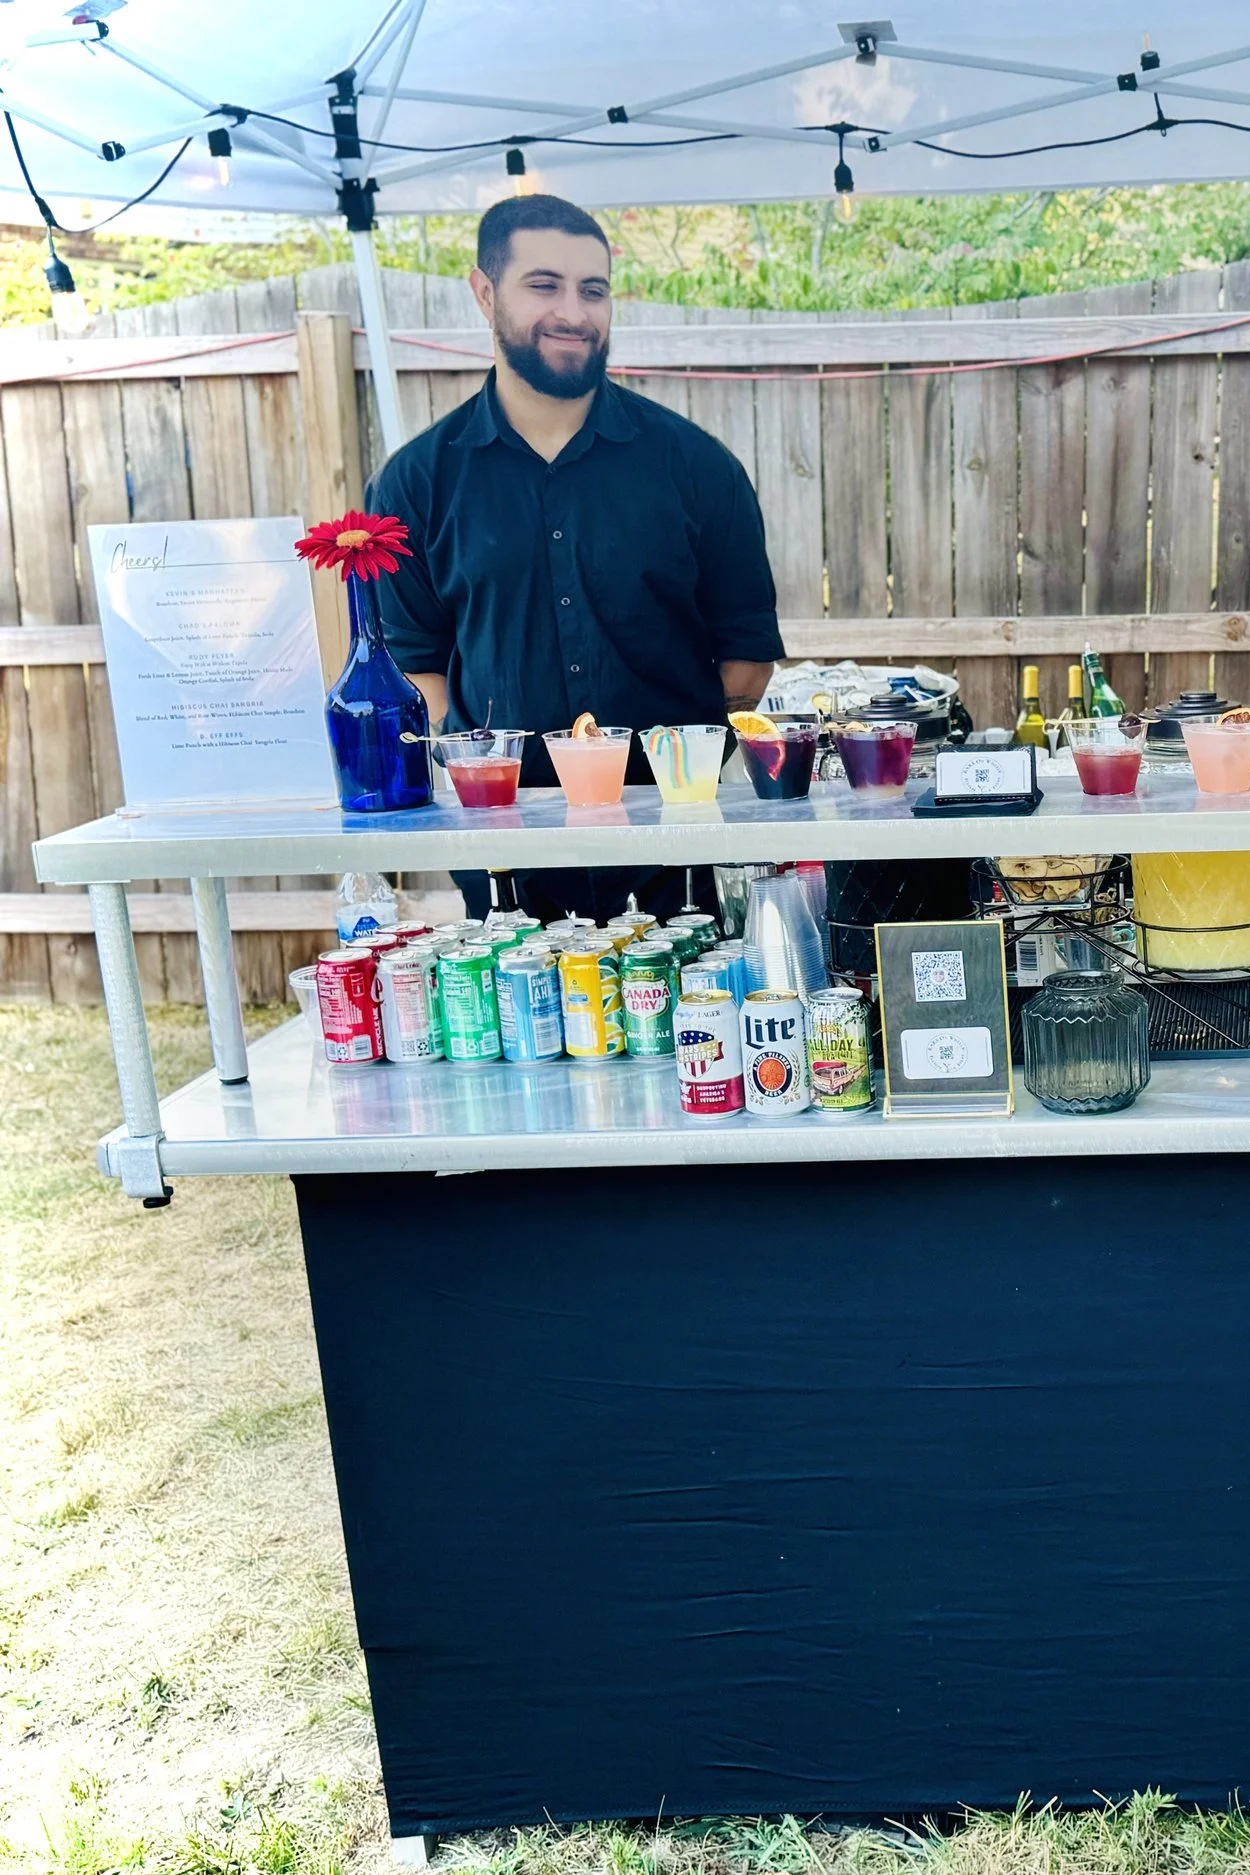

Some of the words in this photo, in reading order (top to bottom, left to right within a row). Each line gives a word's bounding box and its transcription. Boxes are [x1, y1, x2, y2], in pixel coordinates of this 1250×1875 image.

[111, 536, 168, 574] Cheers!
[171, 703, 207, 711] HIBISCUS
[231, 700, 264, 708] SANGRIA
[622, 987, 672, 1000] CANADA
[631, 1000, 658, 1011] DRY
[697, 1010, 721, 1018] LAGER
[374, 1020, 384, 1056] RECYCLE
[626, 1031, 654, 1039] GINGER
[656, 1030, 671, 1038] ALE
[744, 1014, 796, 1050] Lite
[831, 1039, 853, 1051] DAY
[684, 1047, 718, 1062] STRIPES
[768, 1052, 791, 1070] PILSNER
[764, 1089, 783, 1097] BEER
